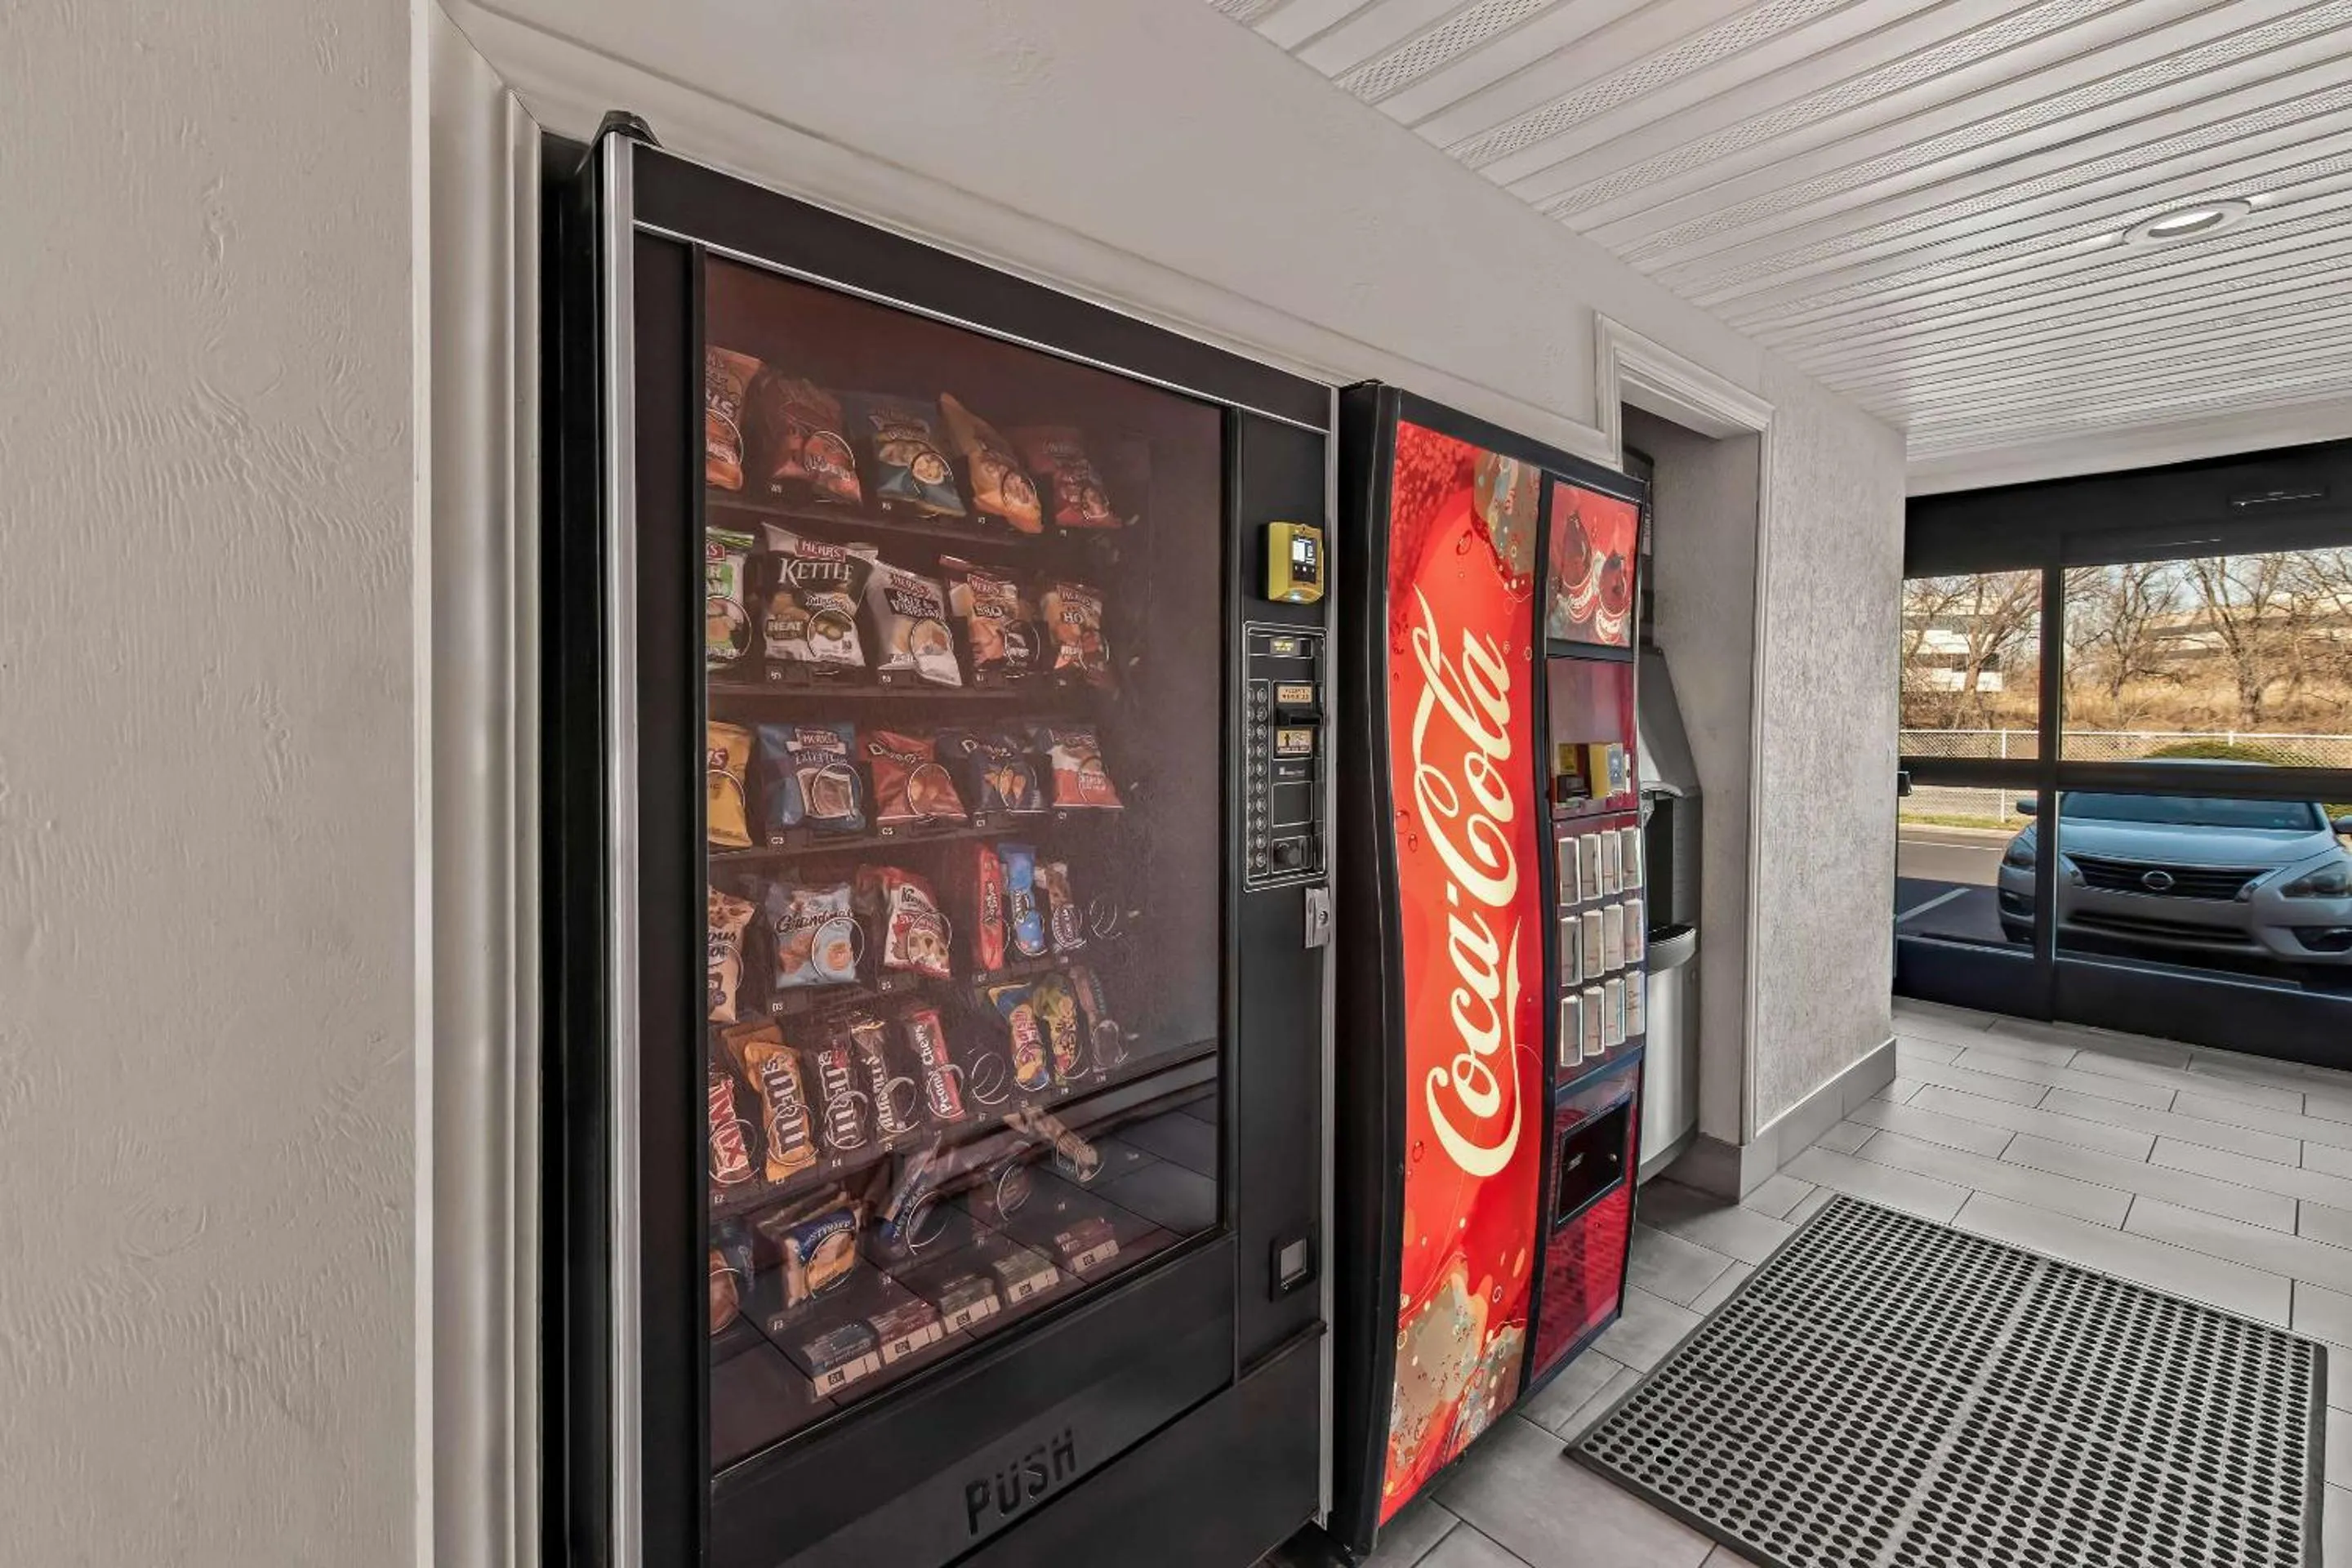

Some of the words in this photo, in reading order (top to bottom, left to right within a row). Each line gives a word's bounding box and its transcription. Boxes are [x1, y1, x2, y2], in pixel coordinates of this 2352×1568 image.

[777, 558, 854, 588] KETTLE
[768, 620, 804, 632] HEAT
[1412, 581, 1522, 1178] Coca-Cola
[915, 1024, 935, 1066] Chews
